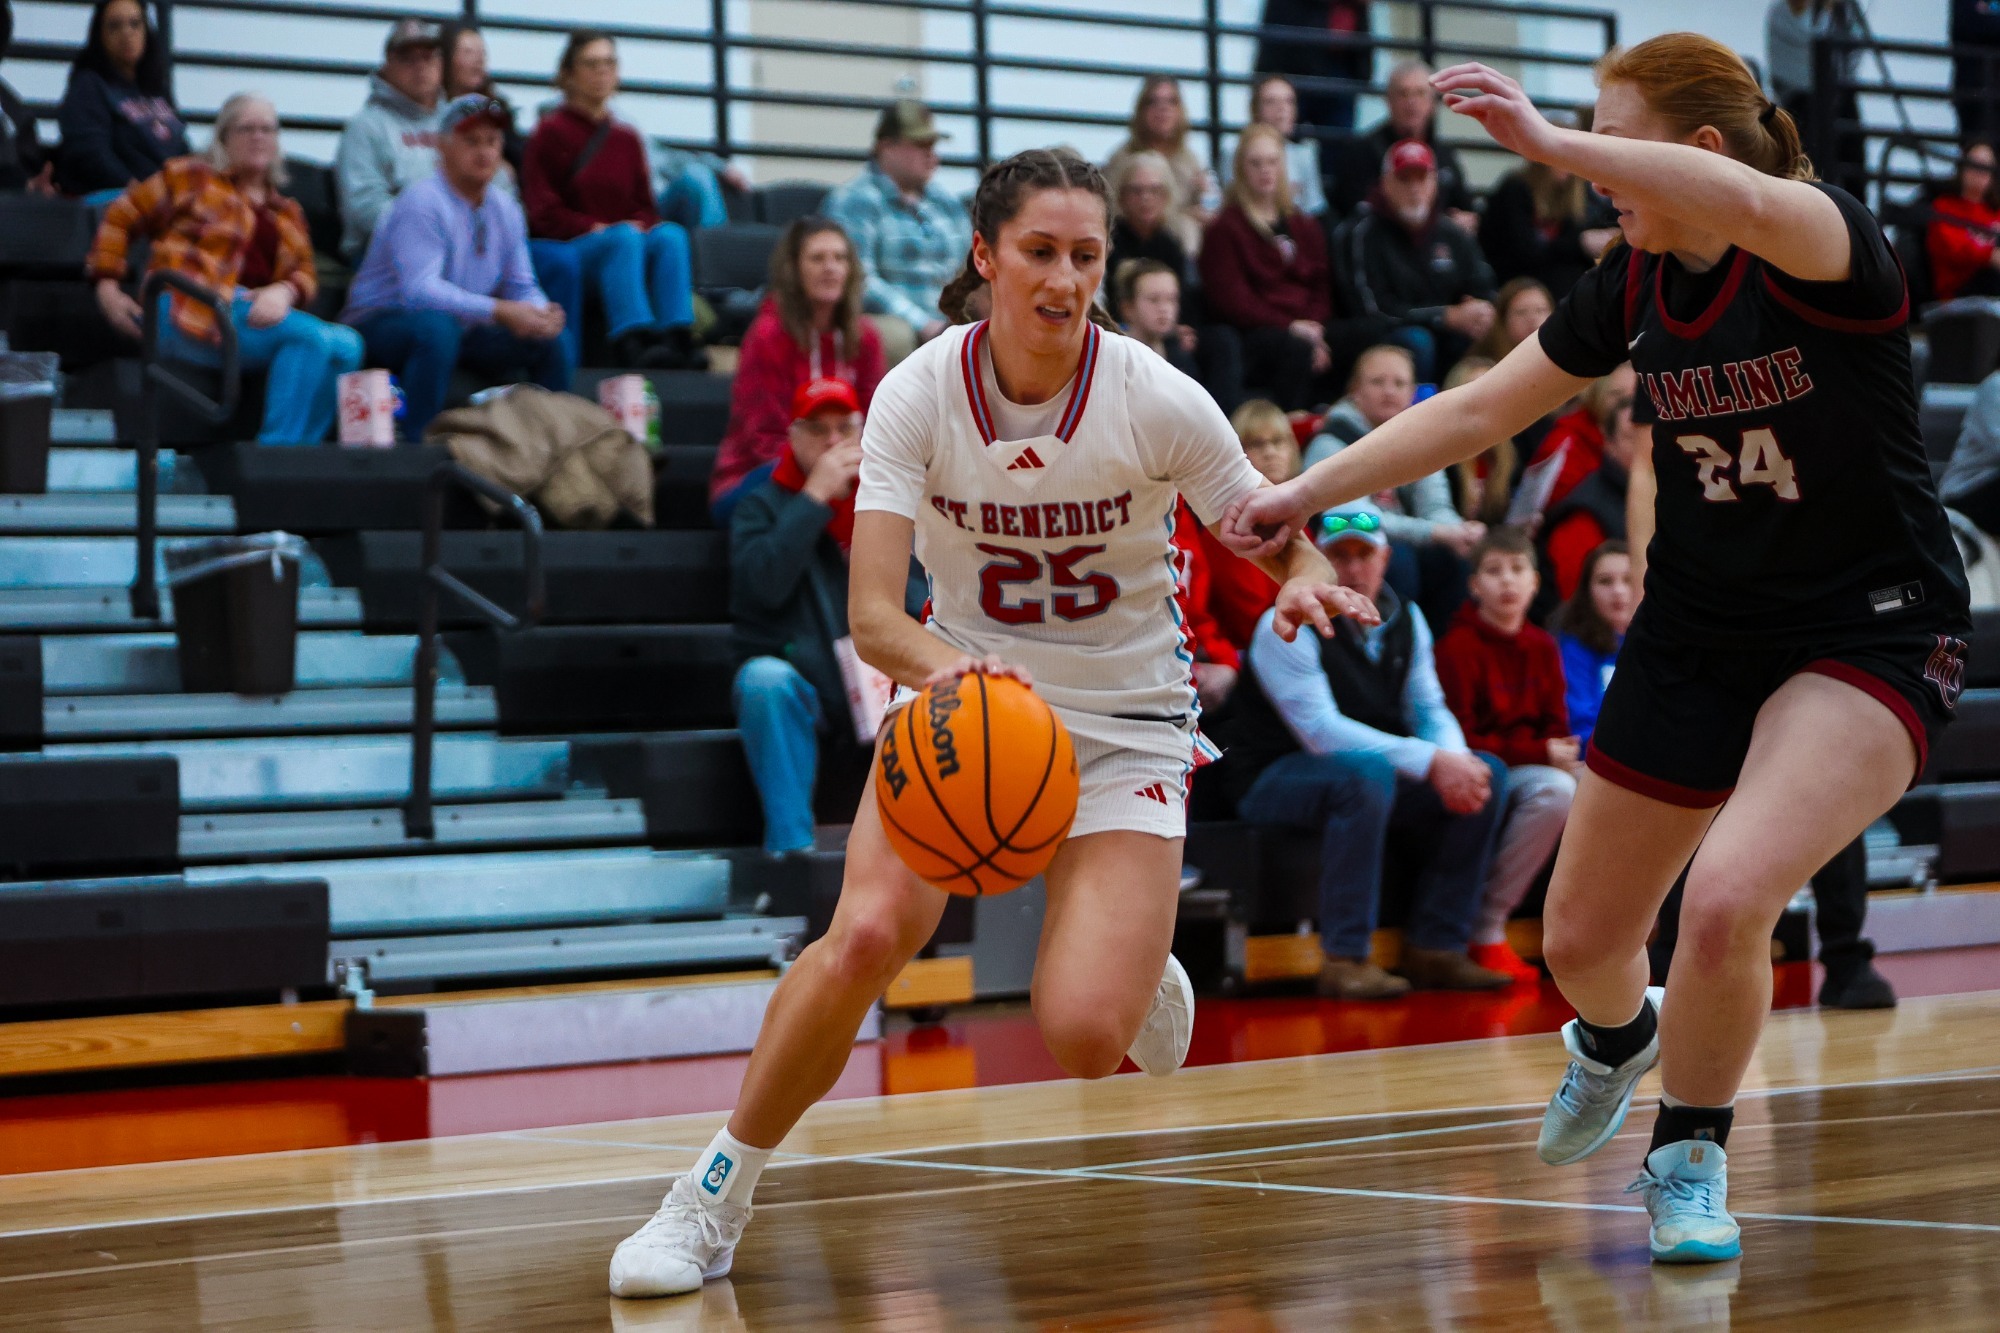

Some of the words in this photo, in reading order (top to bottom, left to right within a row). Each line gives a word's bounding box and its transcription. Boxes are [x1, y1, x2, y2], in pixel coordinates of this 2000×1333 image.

[1638, 346, 1814, 420] AMLINE
[1675, 425, 1801, 502] 24
[980, 489, 1132, 538] BENEDICT
[975, 542, 1120, 626] 25
[1907, 589, 1917, 600] L
[881, 722, 911, 801] CAA
[929, 677, 962, 781] ilson
